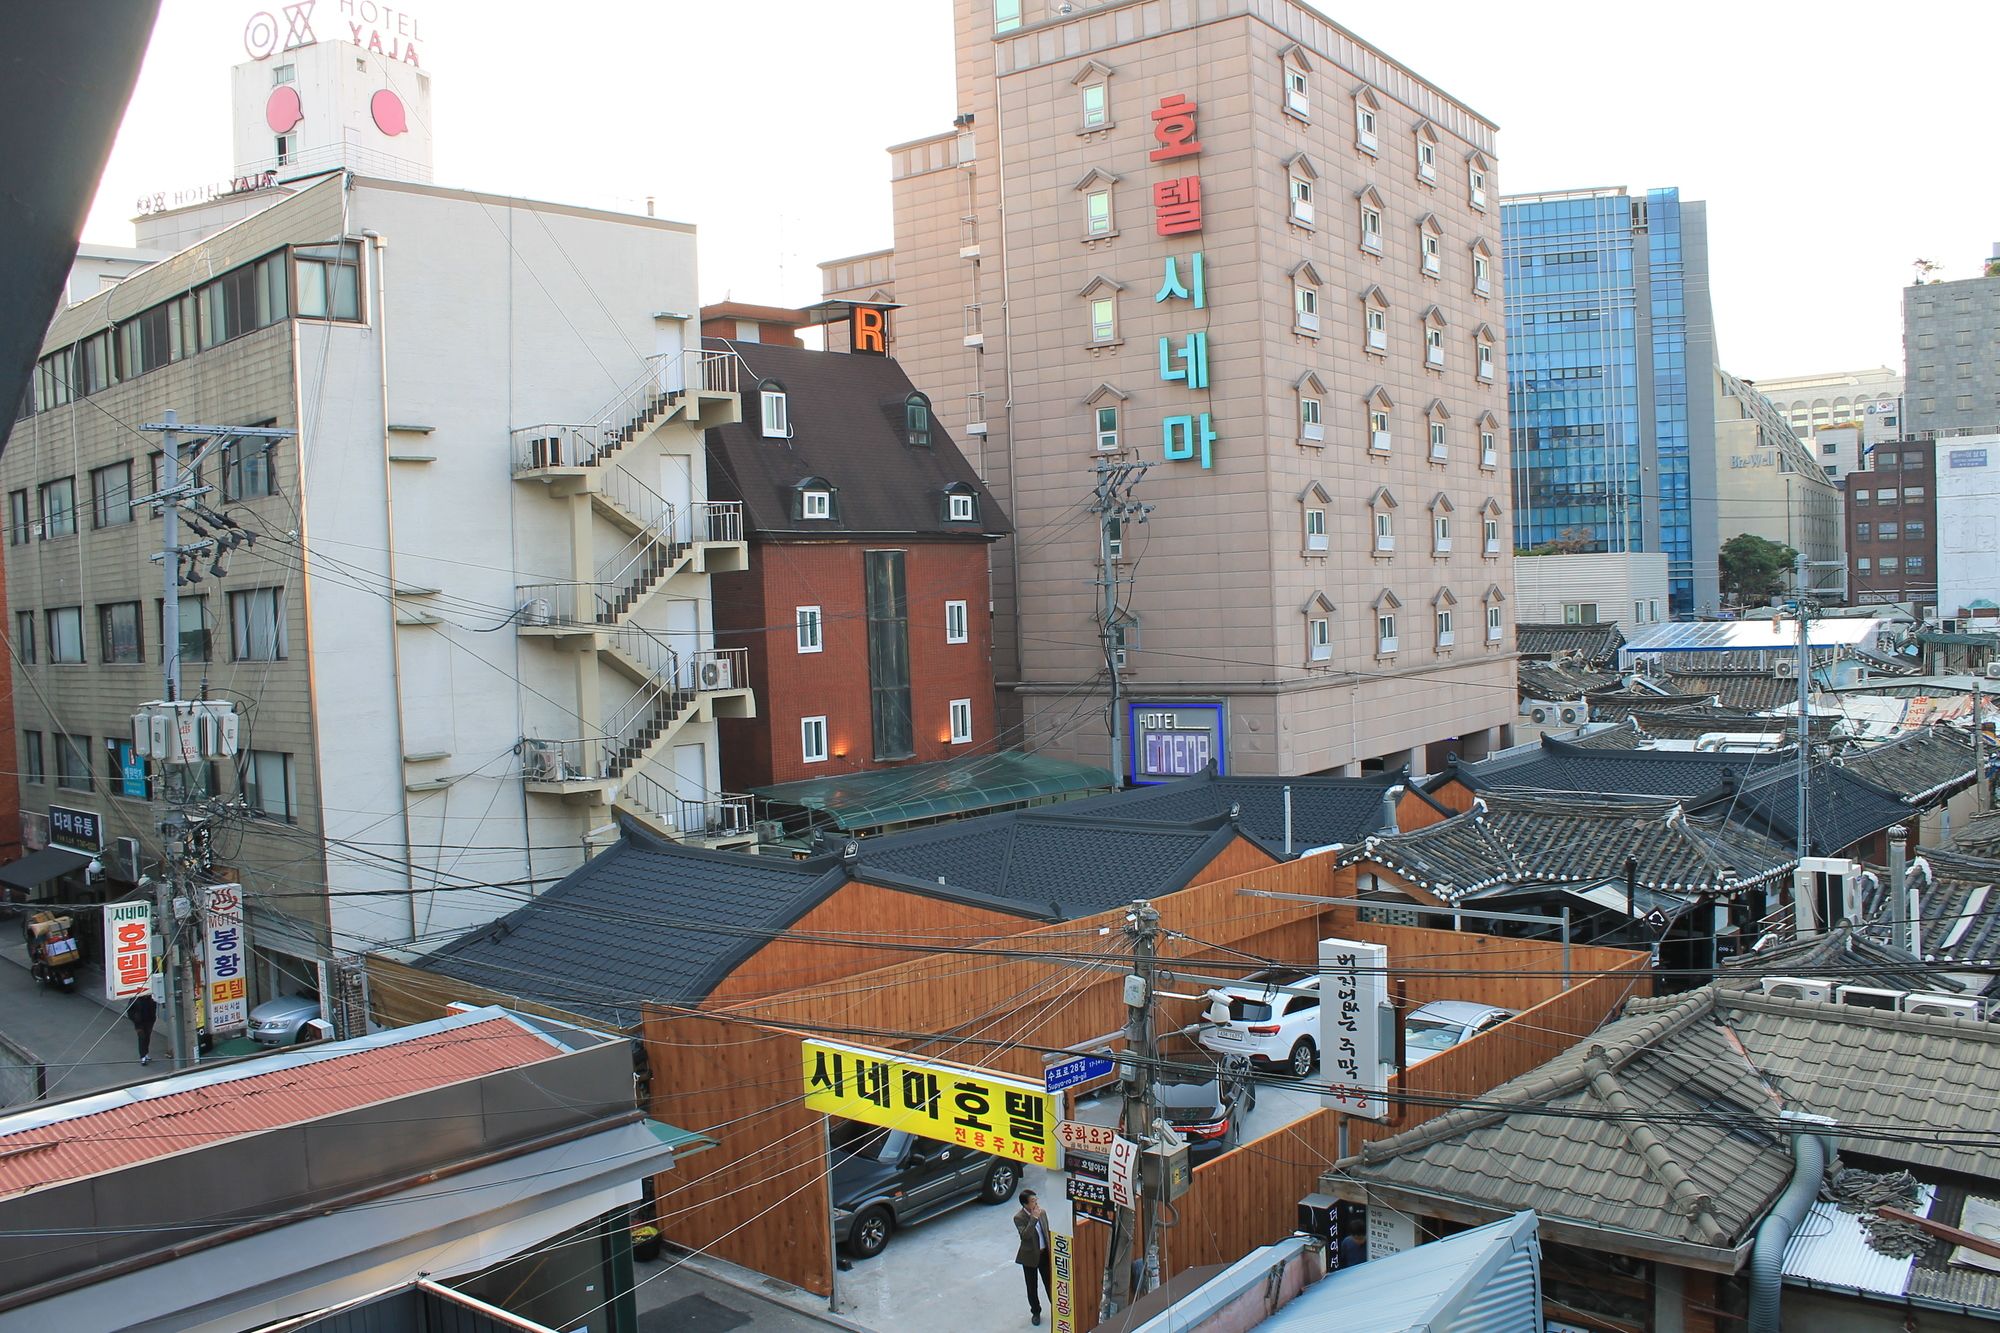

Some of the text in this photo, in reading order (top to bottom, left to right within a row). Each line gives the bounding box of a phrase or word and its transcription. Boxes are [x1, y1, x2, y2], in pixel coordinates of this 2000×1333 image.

[340, 0, 423, 42] HOTEL
[349, 21, 419, 67] YAJA
[229, 172, 273, 193] YAJA
[1149, 93, 1203, 236] 호텔
[855, 306, 884, 352] R
[1155, 251, 1217, 470] 시네마
[114, 905, 149, 920] 시네마
[208, 911, 243, 929] MOTEL
[118, 923, 149, 985] 호텔
[212, 928, 241, 977] 봉황
[213, 978, 244, 1002] 모텔
[954, 1126, 1046, 1164] 전용주차장
[1062, 1122, 1114, 1145] 중화요리
[1081, 1159, 1108, 1174] 호텔야자
[1112, 1143, 1131, 1206] 아구찜
[1054, 1234, 1072, 1280] 호텔
